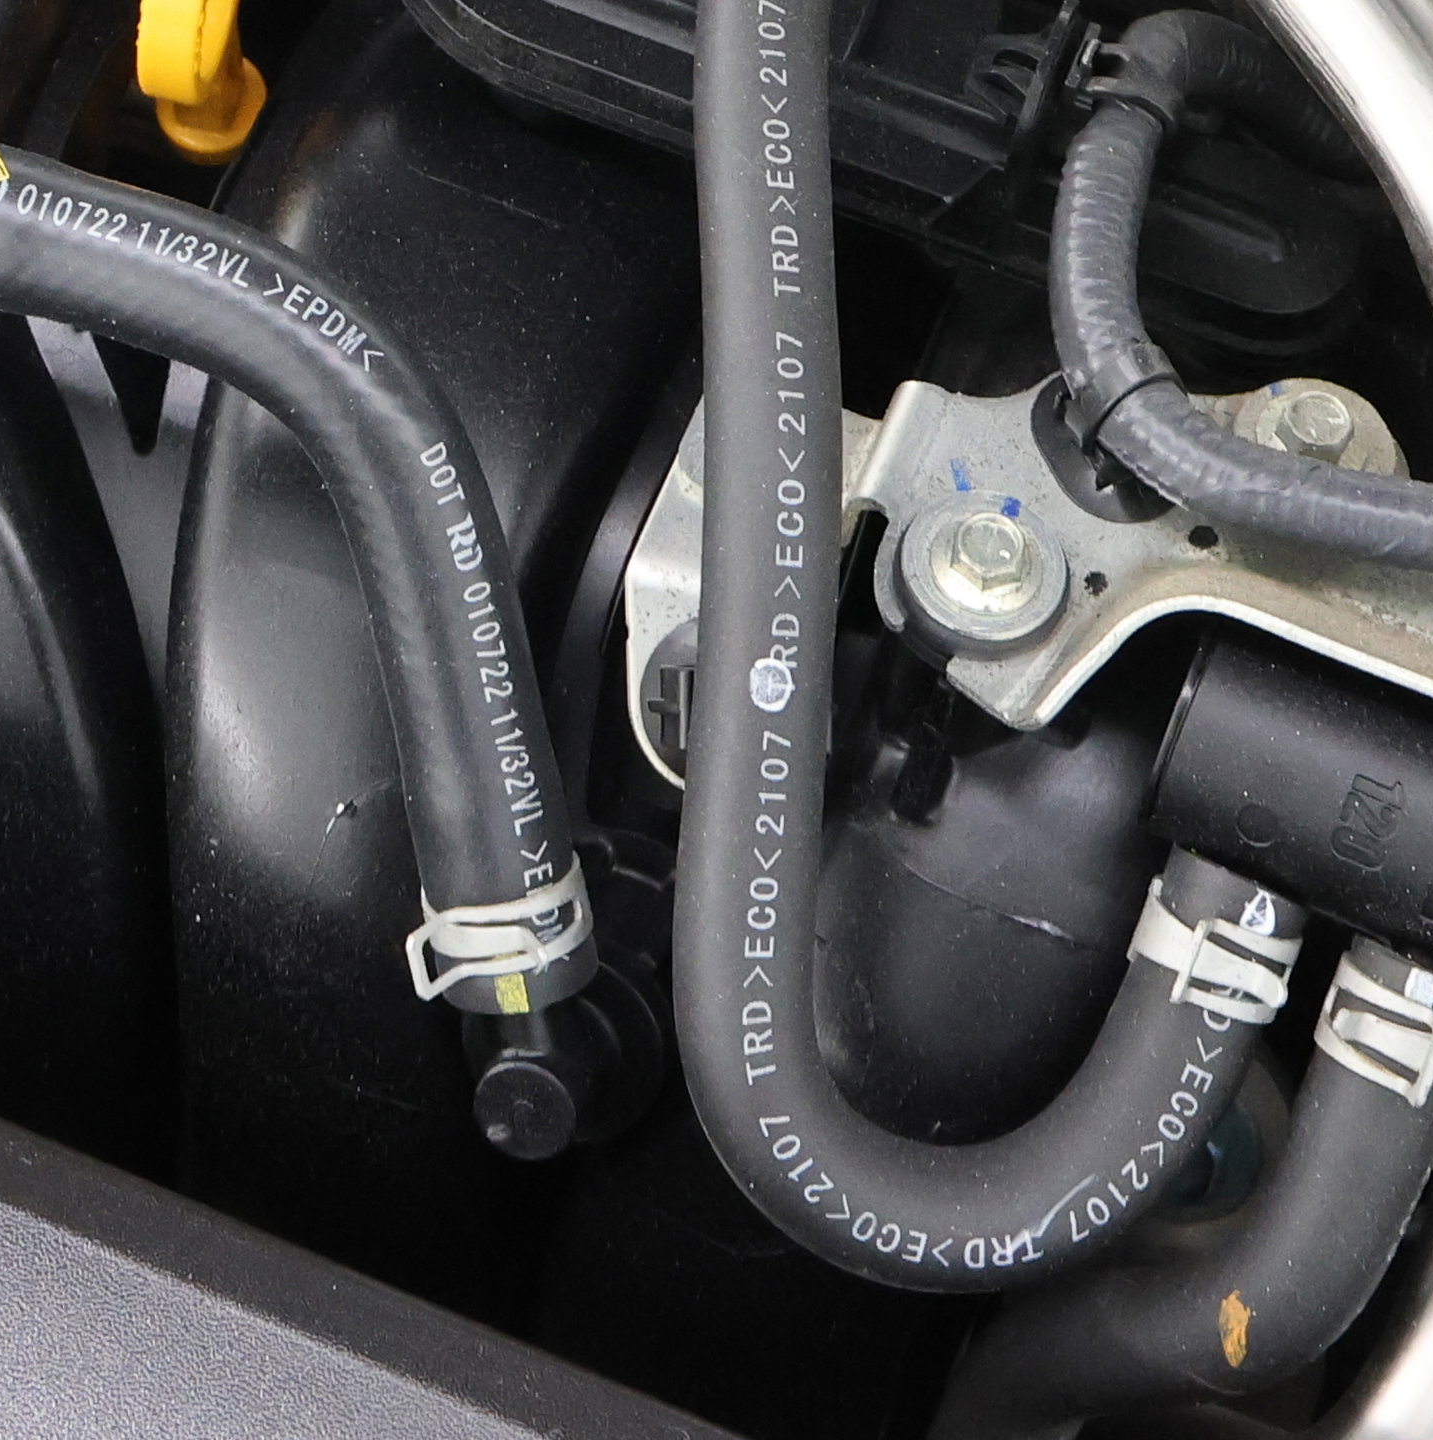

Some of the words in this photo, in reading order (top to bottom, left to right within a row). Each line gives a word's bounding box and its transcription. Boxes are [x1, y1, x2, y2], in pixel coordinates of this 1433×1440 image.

[17, 183, 128, 243] 010722
[420, 441, 465, 506] DOT
[462, 581, 514, 704] 010722
